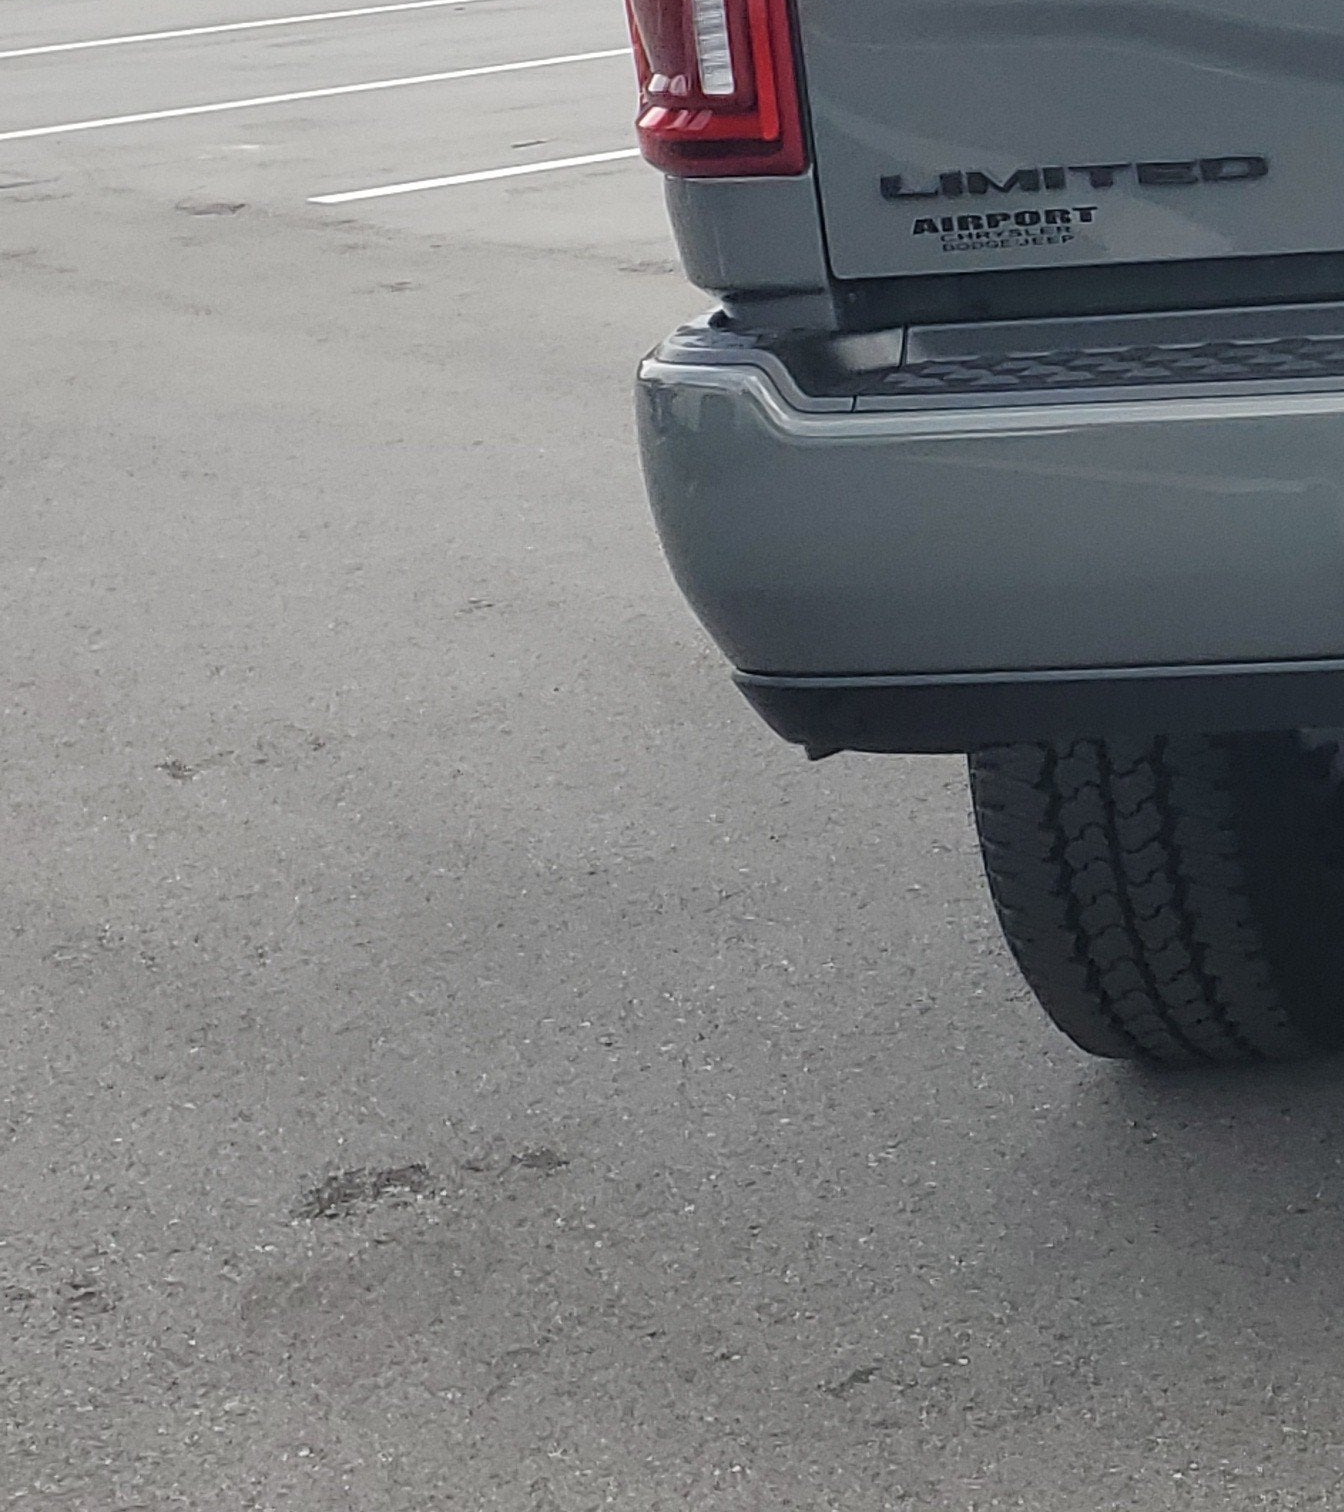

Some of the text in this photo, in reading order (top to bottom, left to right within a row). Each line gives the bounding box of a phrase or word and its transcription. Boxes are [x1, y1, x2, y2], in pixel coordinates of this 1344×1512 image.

[879, 155, 1270, 199] LIMITED
[912, 205, 1098, 235] AIRPORT
[940, 225, 1072, 242] CHRYSLER
